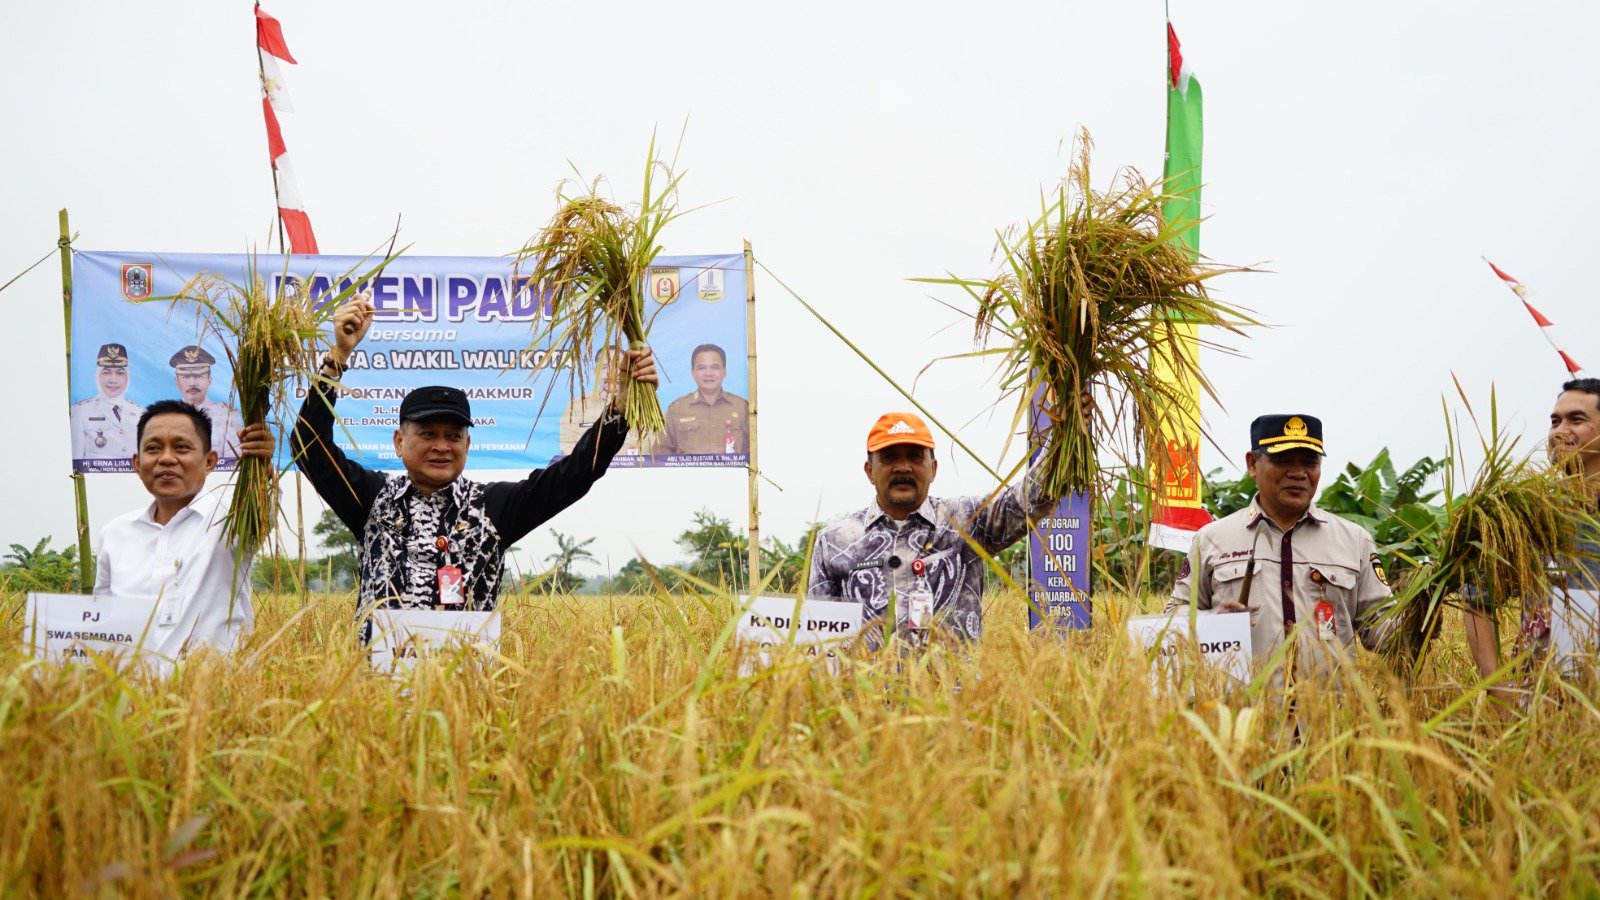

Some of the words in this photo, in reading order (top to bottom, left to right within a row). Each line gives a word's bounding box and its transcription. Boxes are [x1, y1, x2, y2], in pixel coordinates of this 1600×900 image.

[370, 326, 457, 342] bersama
[372, 350, 387, 369] &
[390, 350, 459, 369] WAKIL
[463, 350, 517, 370] WALI
[520, 350, 574, 370] KOTA
[373, 406, 389, 415] JL.
[336, 417, 359, 426] KEL.
[481, 443, 527, 451] PERIKANAN
[92, 460, 113, 468] ERNA
[114, 460, 131, 468] LISA
[1041, 518, 1080, 529] PROGRAM
[1048, 533, 1073, 551] 100
[1044, 554, 1076, 572] HARI
[82, 611, 101, 622] PJ
[807, 619, 850, 633] DPKP
[46, 630, 133, 643] SWASEMBADA
[1200, 640, 1241, 653] DKP3
